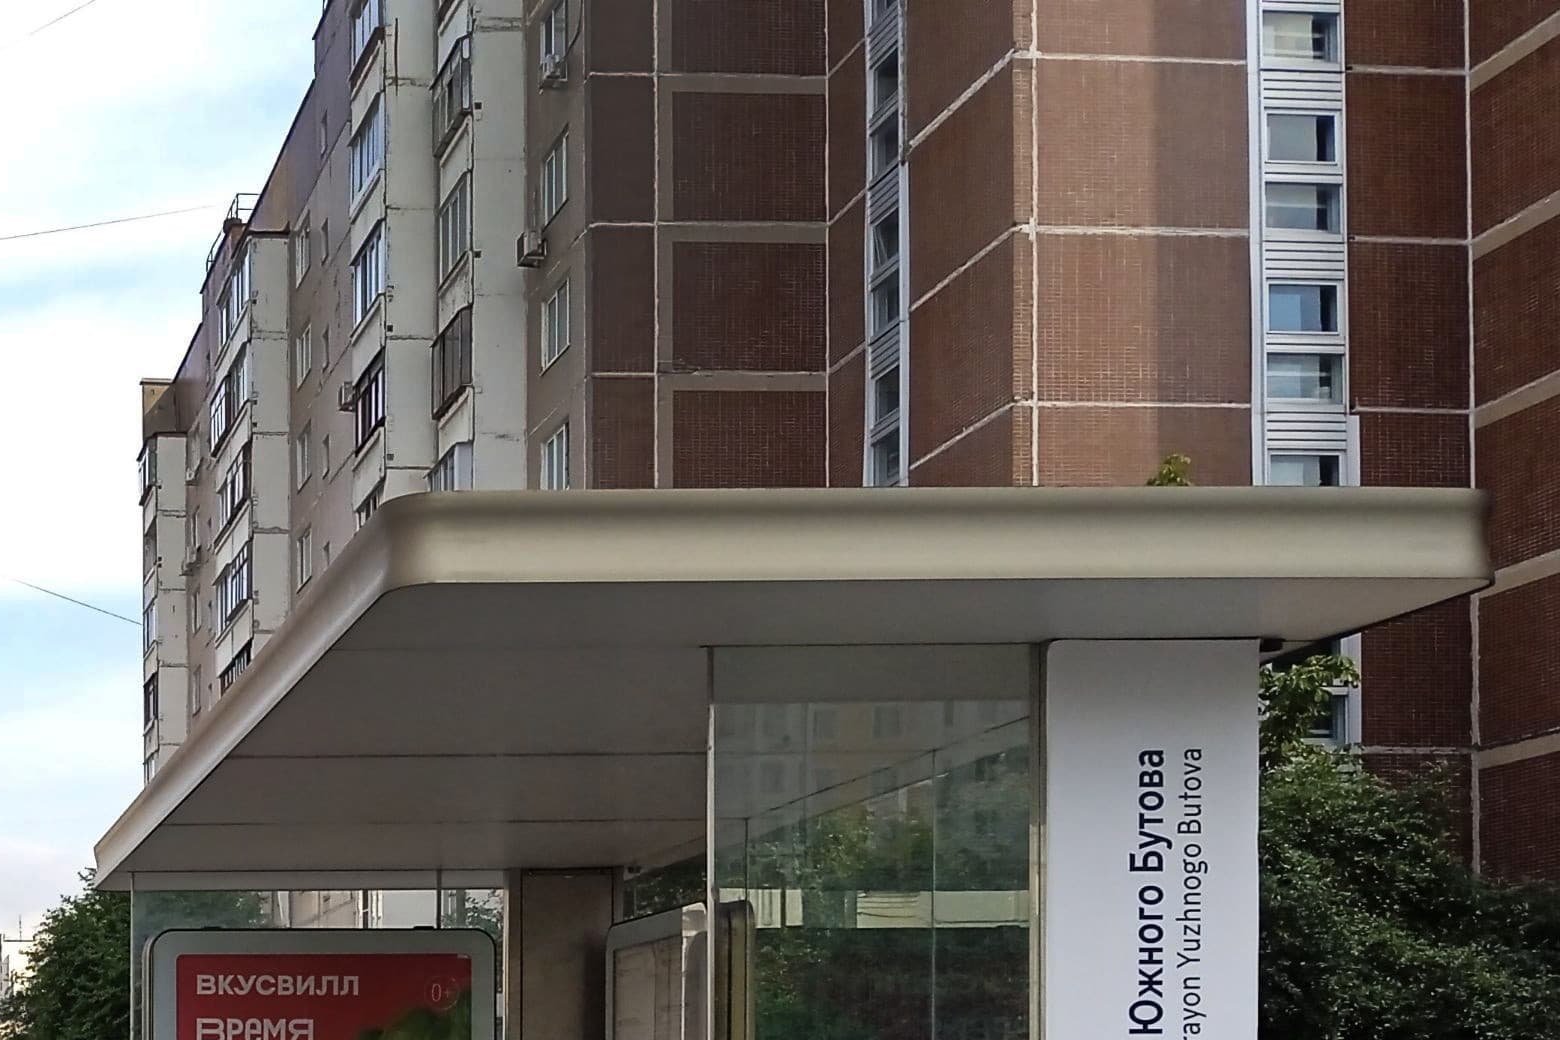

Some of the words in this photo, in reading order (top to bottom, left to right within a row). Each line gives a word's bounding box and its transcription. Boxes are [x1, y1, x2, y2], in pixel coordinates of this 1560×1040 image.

[1128, 750, 1173, 872] Бутова
[1177, 748, 1202, 834] Butova
[1128, 885, 1164, 1034] Южного
[1175, 843, 1208, 969] Yuzhnogo
[196, 974, 360, 997] ВКУСВИЛЛ
